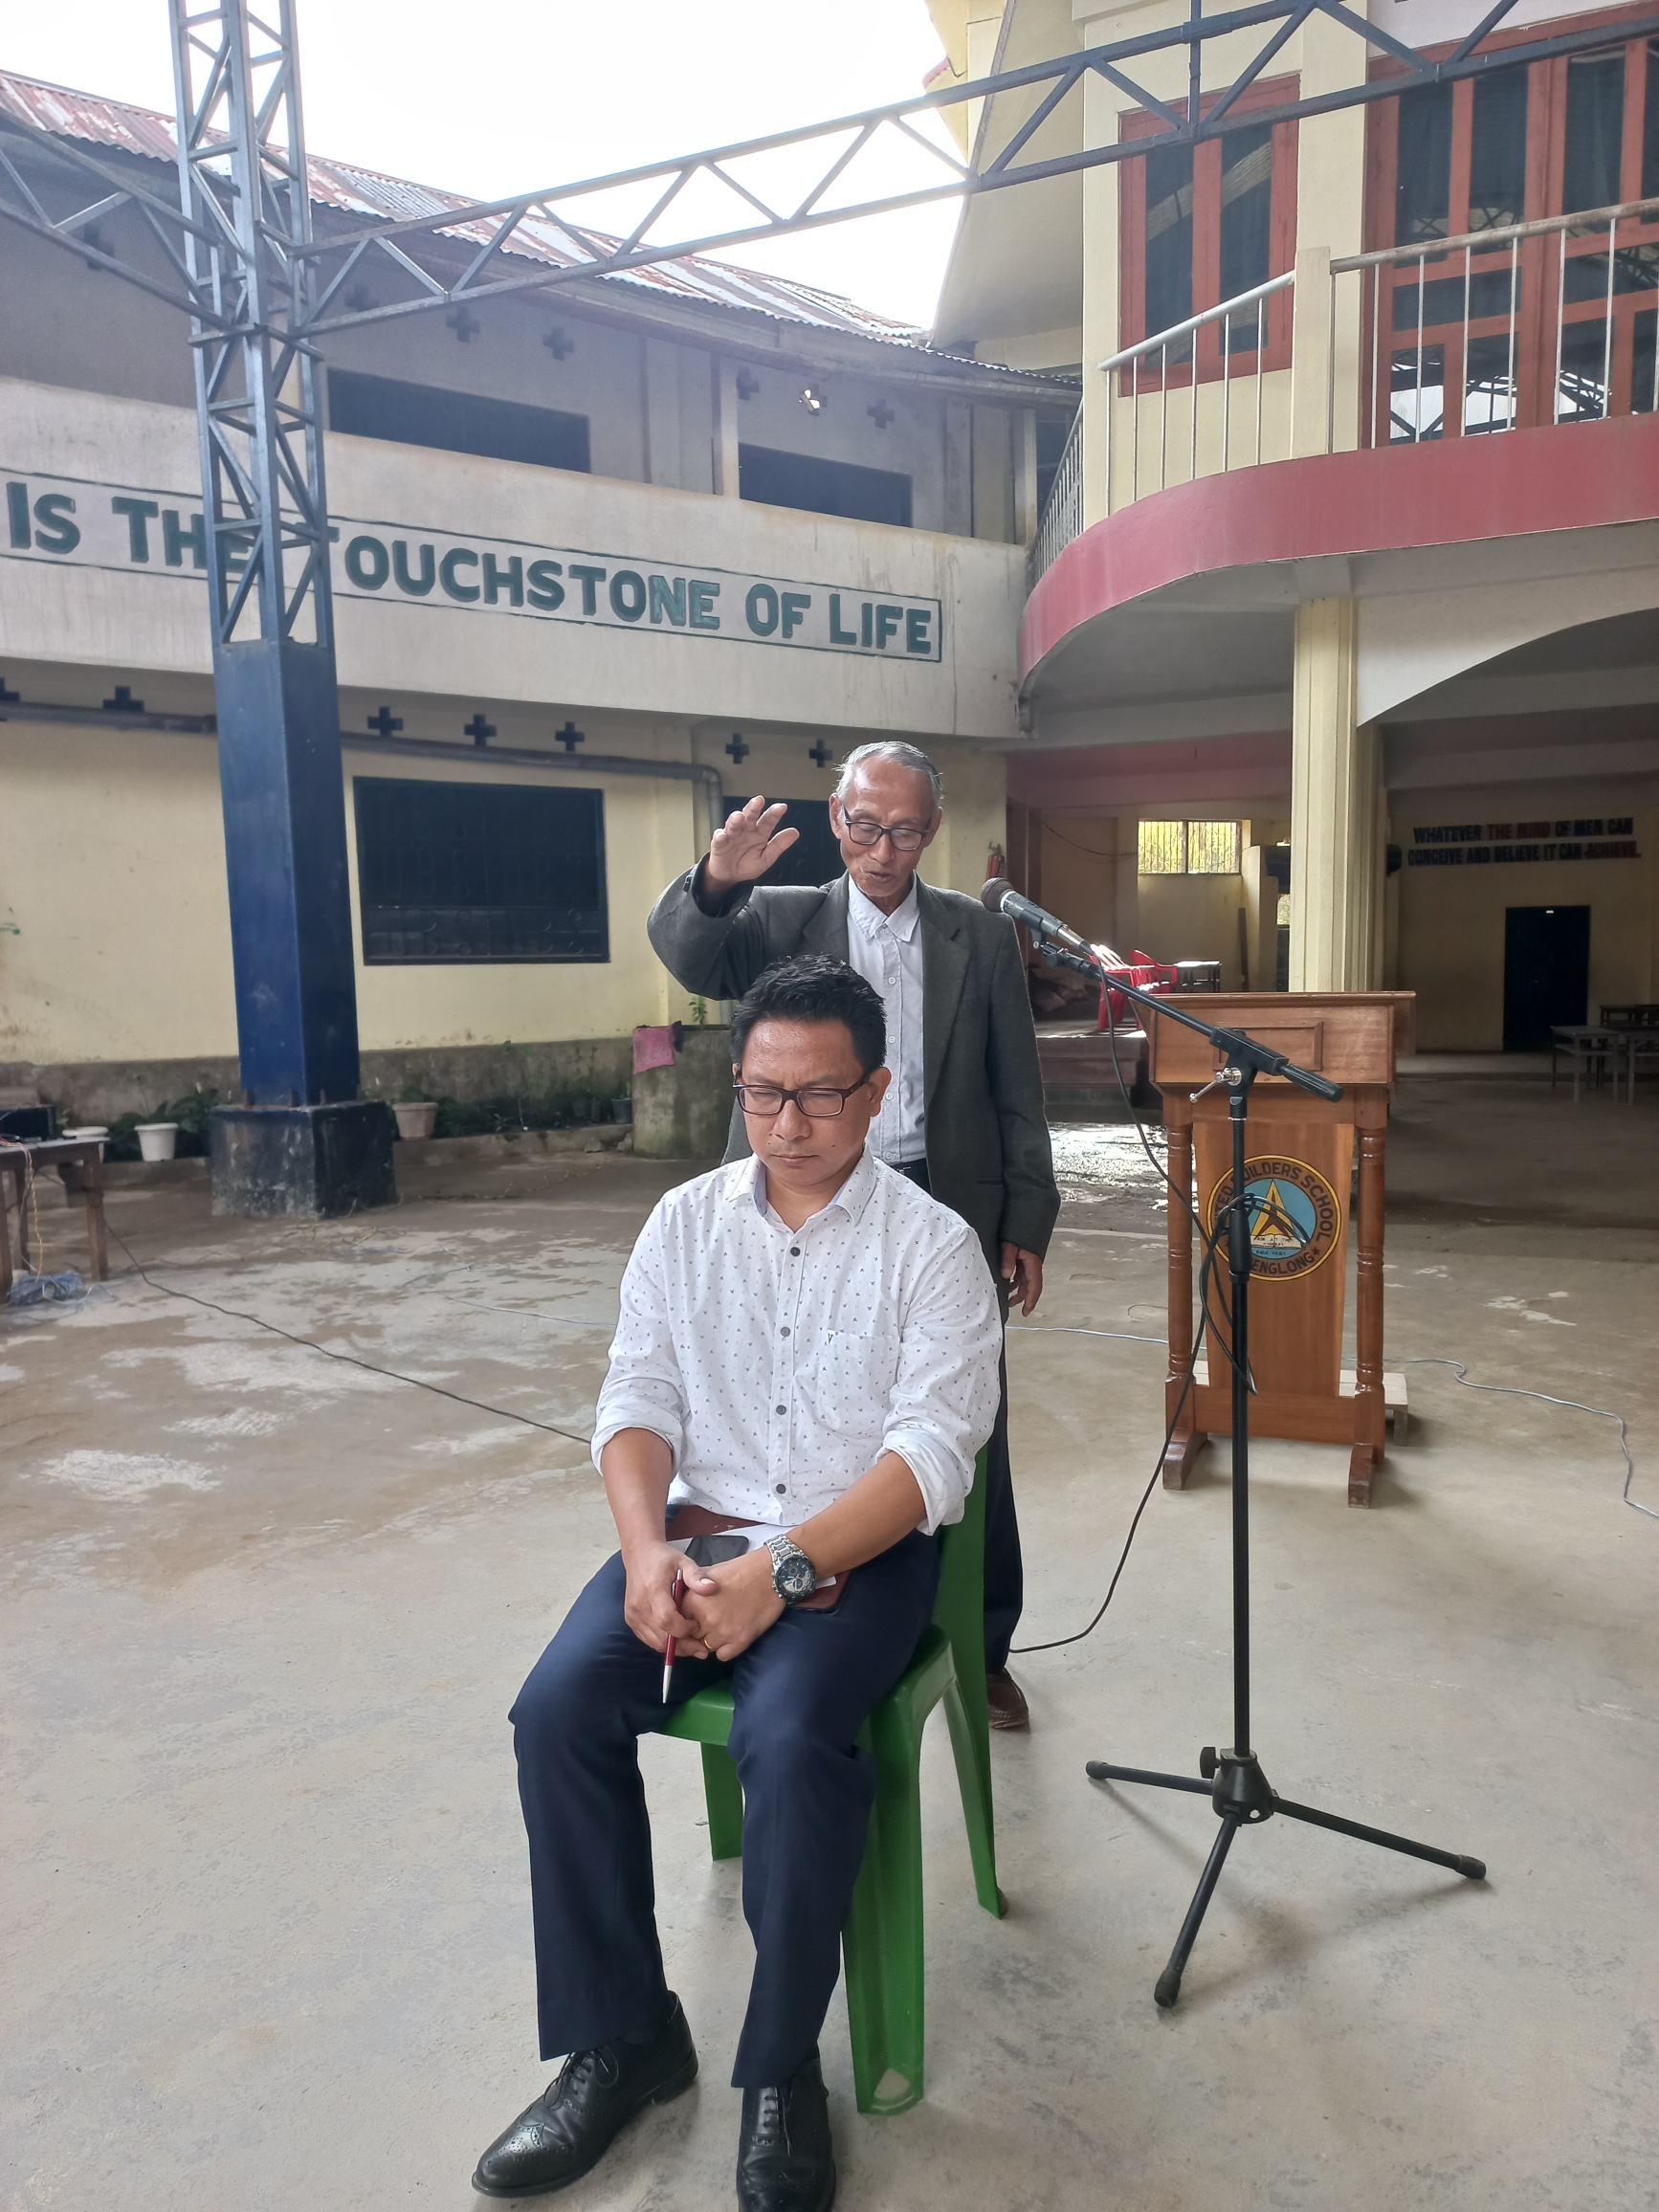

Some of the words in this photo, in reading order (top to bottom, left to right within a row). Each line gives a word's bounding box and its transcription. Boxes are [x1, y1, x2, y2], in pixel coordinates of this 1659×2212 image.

[7, 481, 80, 555] IS
[745, 583, 811, 639] OF
[830, 592, 931, 654] LIFE
[1414, 825, 1482, 844] WHATEVER
[1487, 823, 1513, 841] THE
[1517, 821, 1550, 839] MIND
[1556, 820, 1571, 838] OF
[1574, 819, 1604, 837] MEN
[1608, 817, 1633, 835] CAN
[1408, 848, 1463, 866] CONCEIVE
[1467, 846, 1491, 864] AND
[1494, 844, 1540, 863] BELIEVE
[1544, 844, 1557, 861] IT
[1559, 842, 1582, 860] CAN
[1230, 1162, 1302, 1186] UILDERS
[1300, 1175, 1334, 1242] SCHOOL
[1250, 1250, 1316, 1274] ENGLONG
